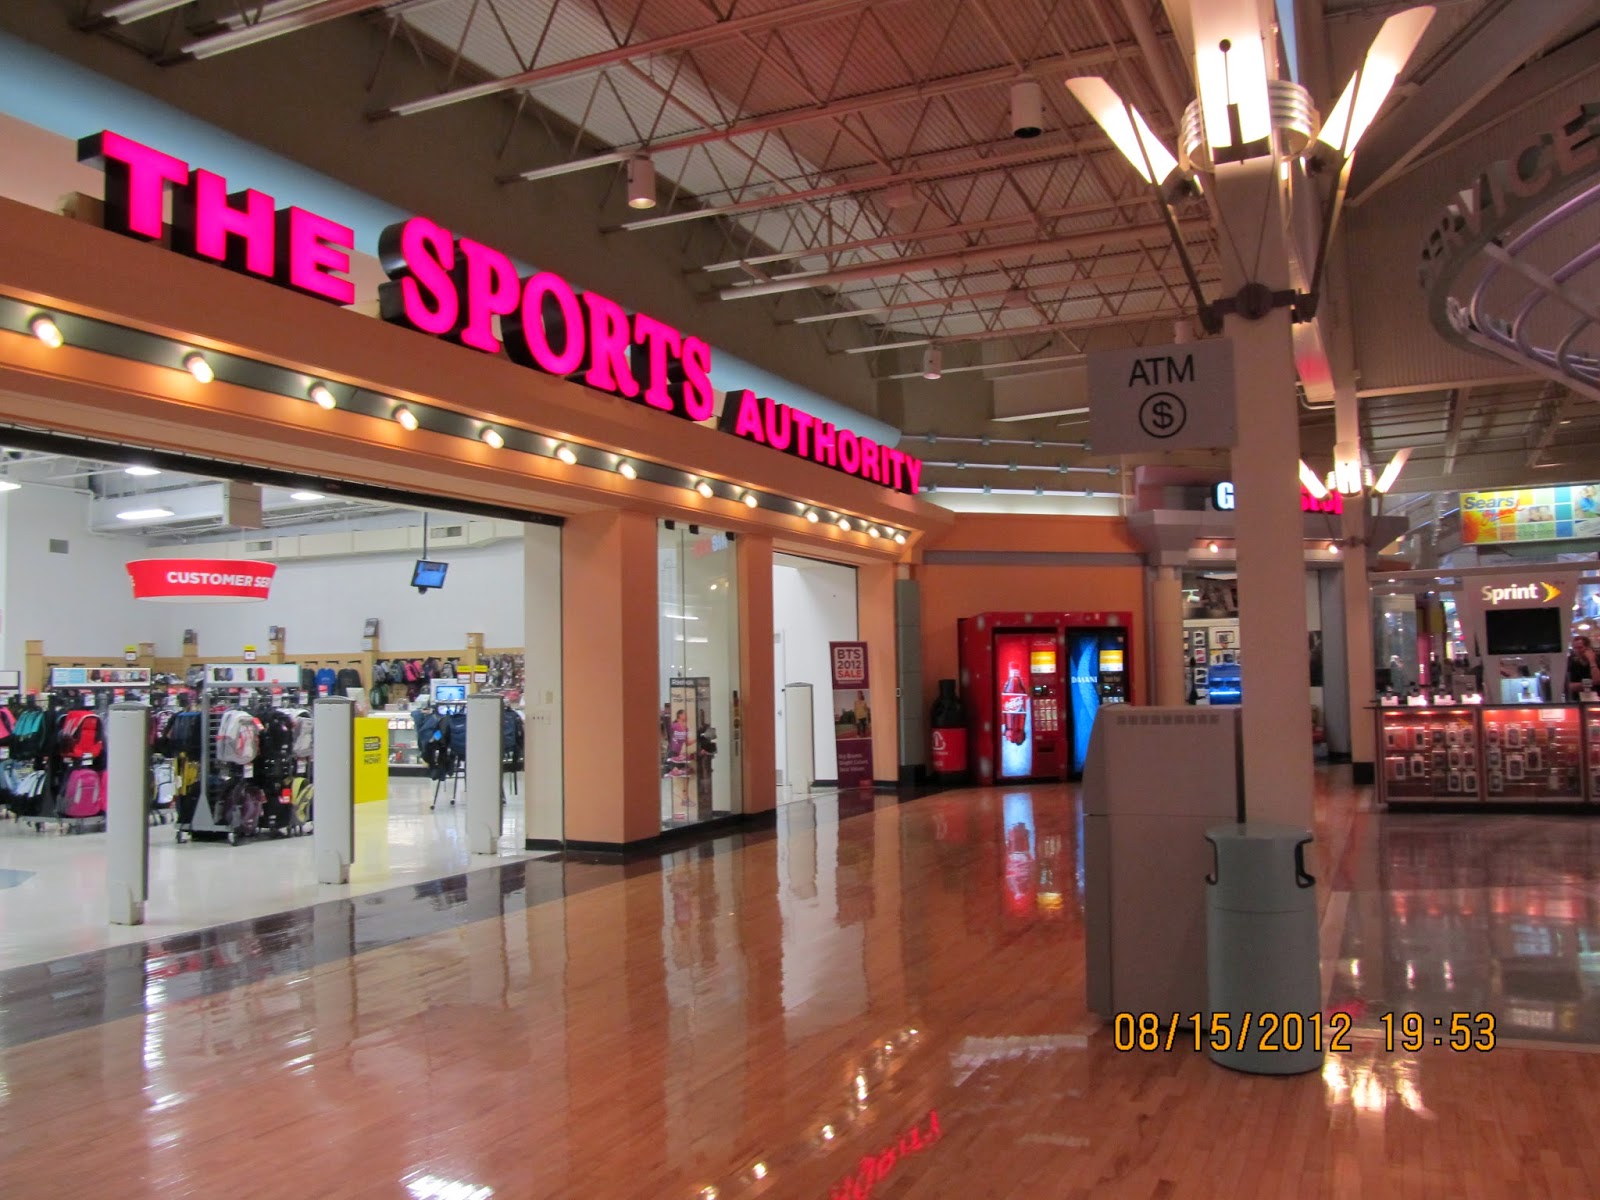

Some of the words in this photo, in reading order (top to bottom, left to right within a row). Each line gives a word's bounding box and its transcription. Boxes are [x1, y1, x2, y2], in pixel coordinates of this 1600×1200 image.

[100, 130, 356, 305] THE
[401, 216, 715, 422] SPORTS
[735, 388, 923, 495] AUTHORITY
[1128, 354, 1195, 387] ATM
[1463, 495, 1515, 511] Sears
[166, 571, 253, 587] CUSTOMER
[1481, 583, 1539, 605] Sprint
[837, 648, 861, 660] BTS
[837, 660, 862, 670] 2012
[838, 670, 862, 679] SALE
